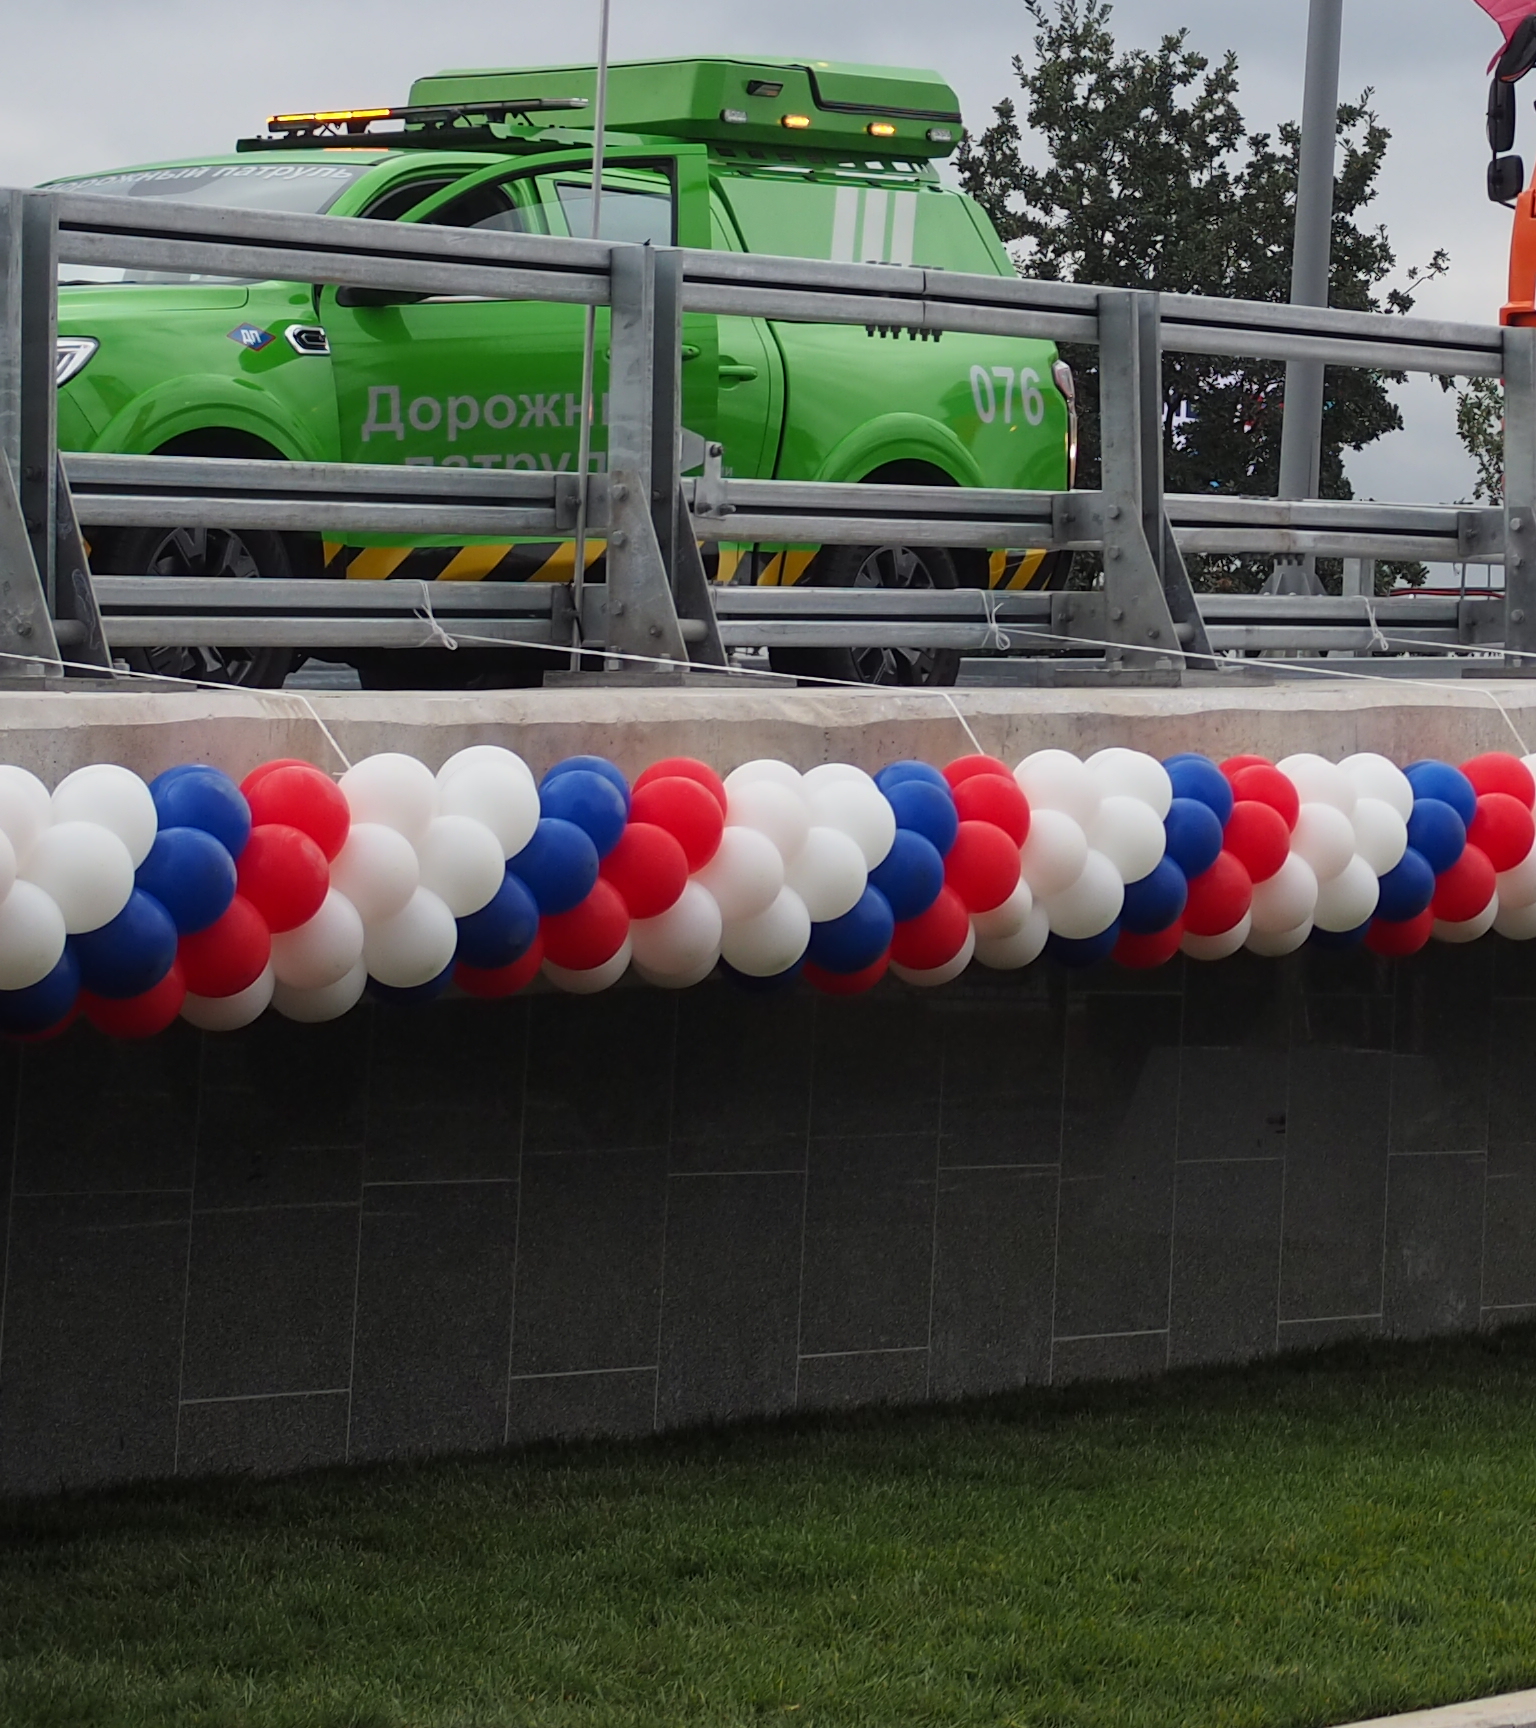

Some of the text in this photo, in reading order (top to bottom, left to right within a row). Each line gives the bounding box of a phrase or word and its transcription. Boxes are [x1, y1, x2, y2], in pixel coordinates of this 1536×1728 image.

[240, 329, 262, 345] ДП
[361, 385, 609, 442] Дорожн
[969, 364, 1044, 426] 076
